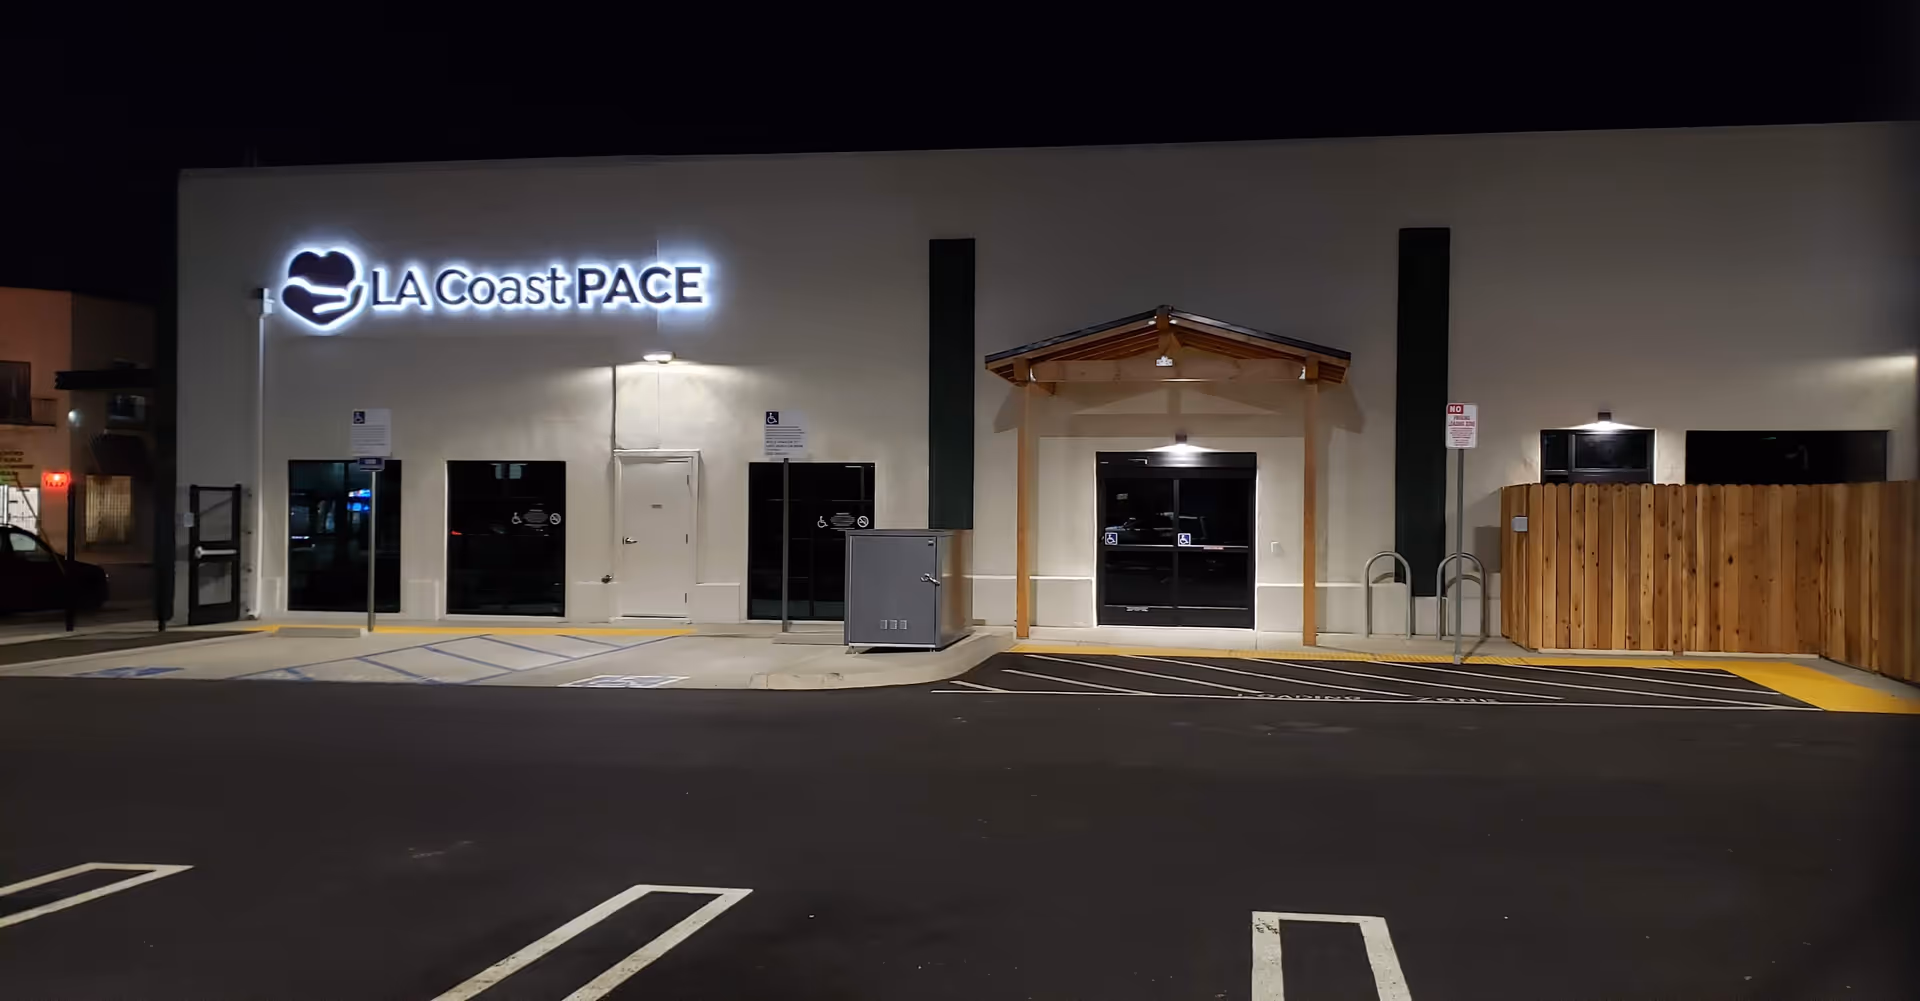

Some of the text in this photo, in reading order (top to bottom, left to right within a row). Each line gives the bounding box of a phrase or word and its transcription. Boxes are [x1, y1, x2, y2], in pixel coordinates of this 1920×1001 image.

[371, 265, 703, 306] LA Coast PACE
[1449, 405, 1462, 413] NO
